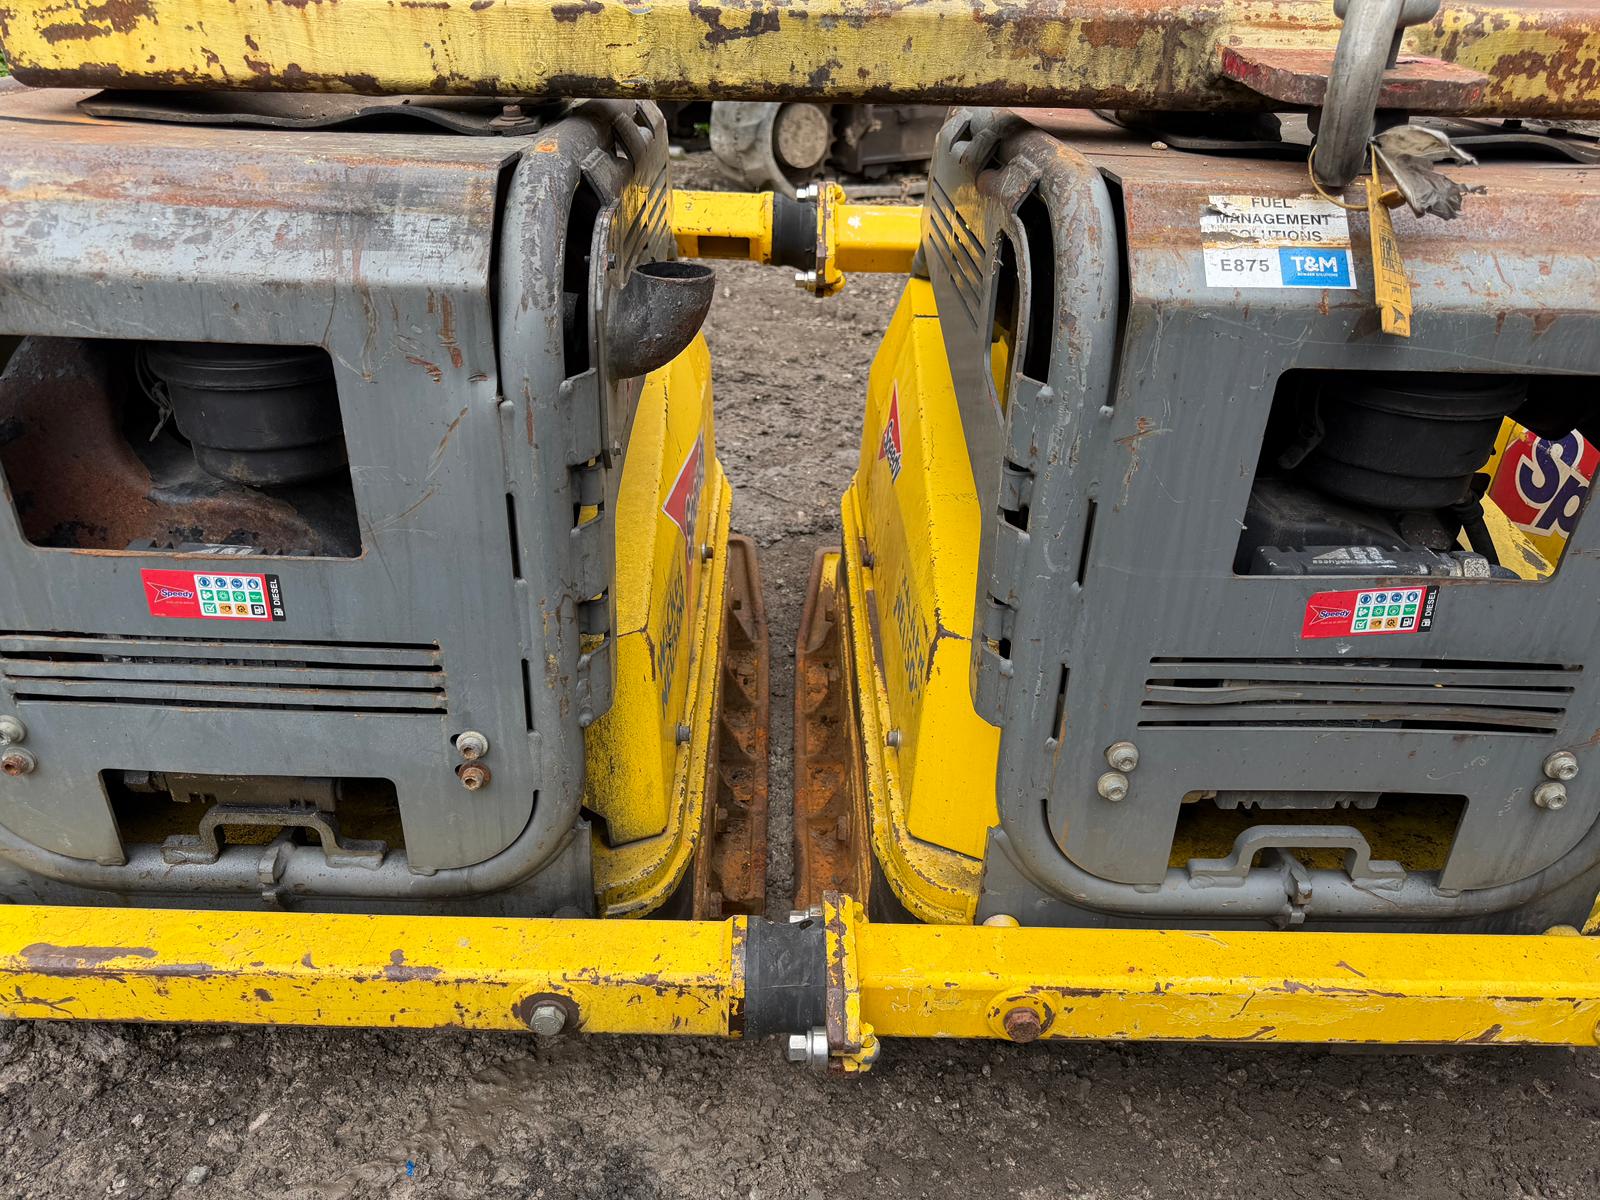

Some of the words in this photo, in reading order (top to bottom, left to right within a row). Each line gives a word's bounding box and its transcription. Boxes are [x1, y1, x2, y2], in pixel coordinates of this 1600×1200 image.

[1252, 197, 1292, 209] FUEL
[1216, 213, 1330, 226] MANAGEMENT
[1229, 229, 1323, 242] OUTIONS
[1220, 259, 1270, 273] E875
[1290, 256, 1338, 273] T&M
[160, 588, 194, 599] Speedy
[270, 579, 281, 605] DIESEL
[1424, 590, 1437, 616] DIESEL
[1319, 609, 1351, 619] Speedy
